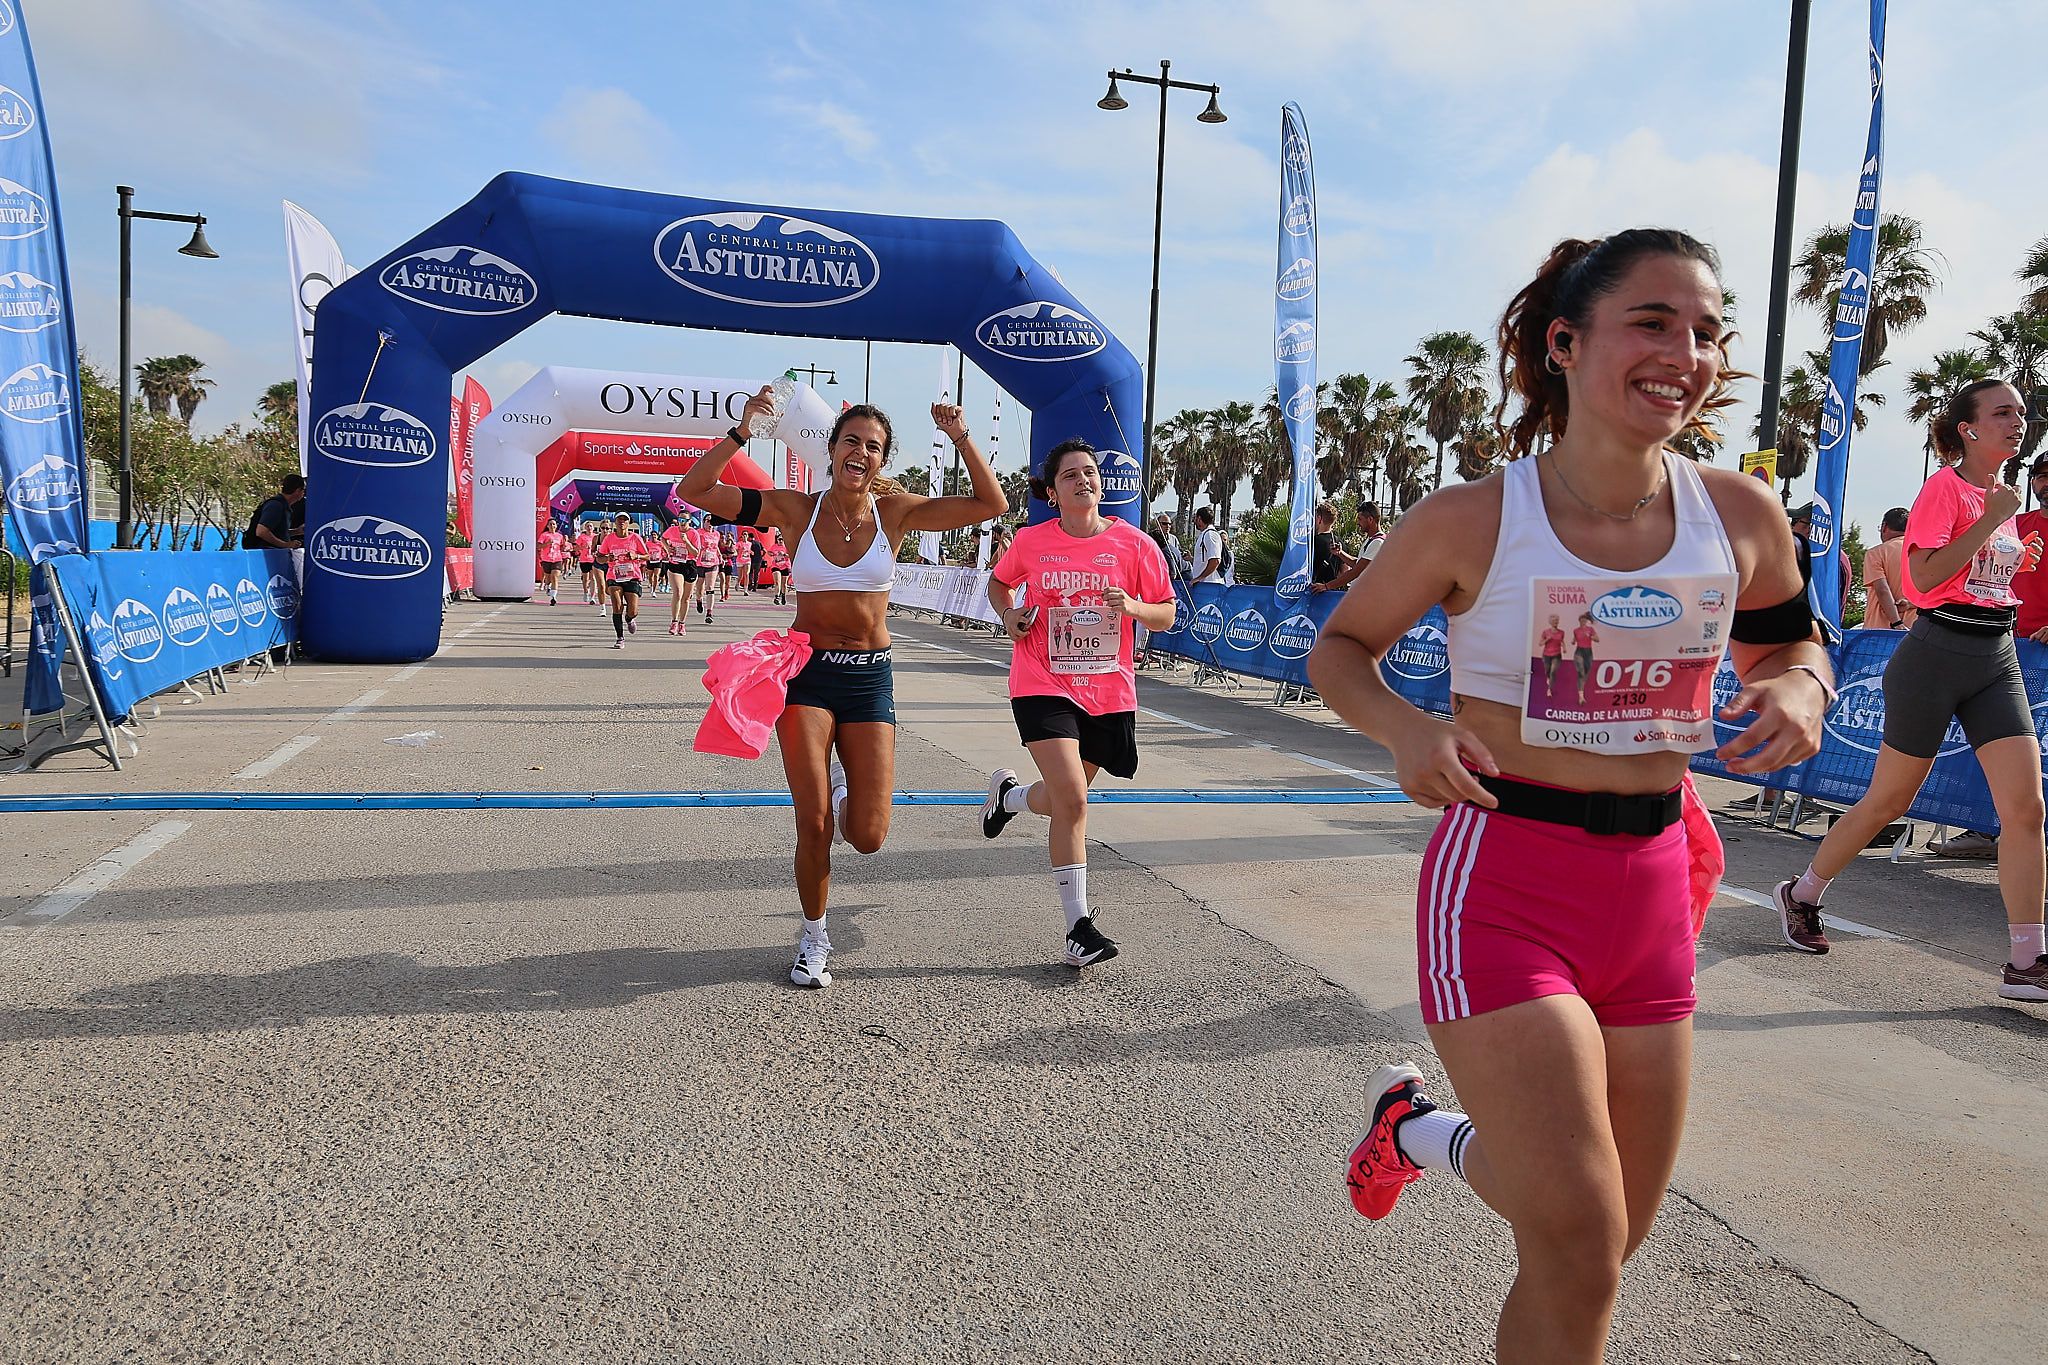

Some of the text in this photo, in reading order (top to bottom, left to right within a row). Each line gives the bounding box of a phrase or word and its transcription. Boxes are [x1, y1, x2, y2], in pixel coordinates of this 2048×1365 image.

[708, 232, 856, 256] CENTRAL LECHERA
[671, 231, 862, 288] ASTURIANA
[416, 263, 524, 285] CENTRAL LECHERA
[388, 264, 525, 304] ASTURIANA
[987, 324, 1100, 346] ASTURIANA
[1055, 322, 1092, 331] LECHERA
[600, 382, 751, 422] OYSHO
[502, 412, 552, 426] OYSHO
[335, 420, 426, 438] CENTRAL LECHERA
[319, 422, 429, 456] ASTURIANA
[584, 441, 708, 458] Sports Santander
[480, 476, 526, 488] OYSHO
[331, 534, 422, 548] CENTRAL LECHERA
[478, 540, 525, 552] OYSHO
[315, 535, 424, 567] ASTURIANA
[1994, 564, 2012, 576] 016
[1548, 593, 1587, 604] SUMA
[1598, 602, 1676, 618] ASTURIANA
[1228, 622, 1262, 642] ASTURIANA
[1272, 628, 1312, 650] ASTURIANA
[1074, 637, 1100, 648] 016
[822, 650, 891, 665] NIKE PR
[1389, 642, 1446, 669] ASTURIANA
[1596, 660, 1673, 688] 016
[1612, 692, 1647, 706] 2130
[1545, 708, 1702, 721] CARRERA DE LA MUJER VALENCIA
[1545, 729, 1702, 745] OYSHO Santander
